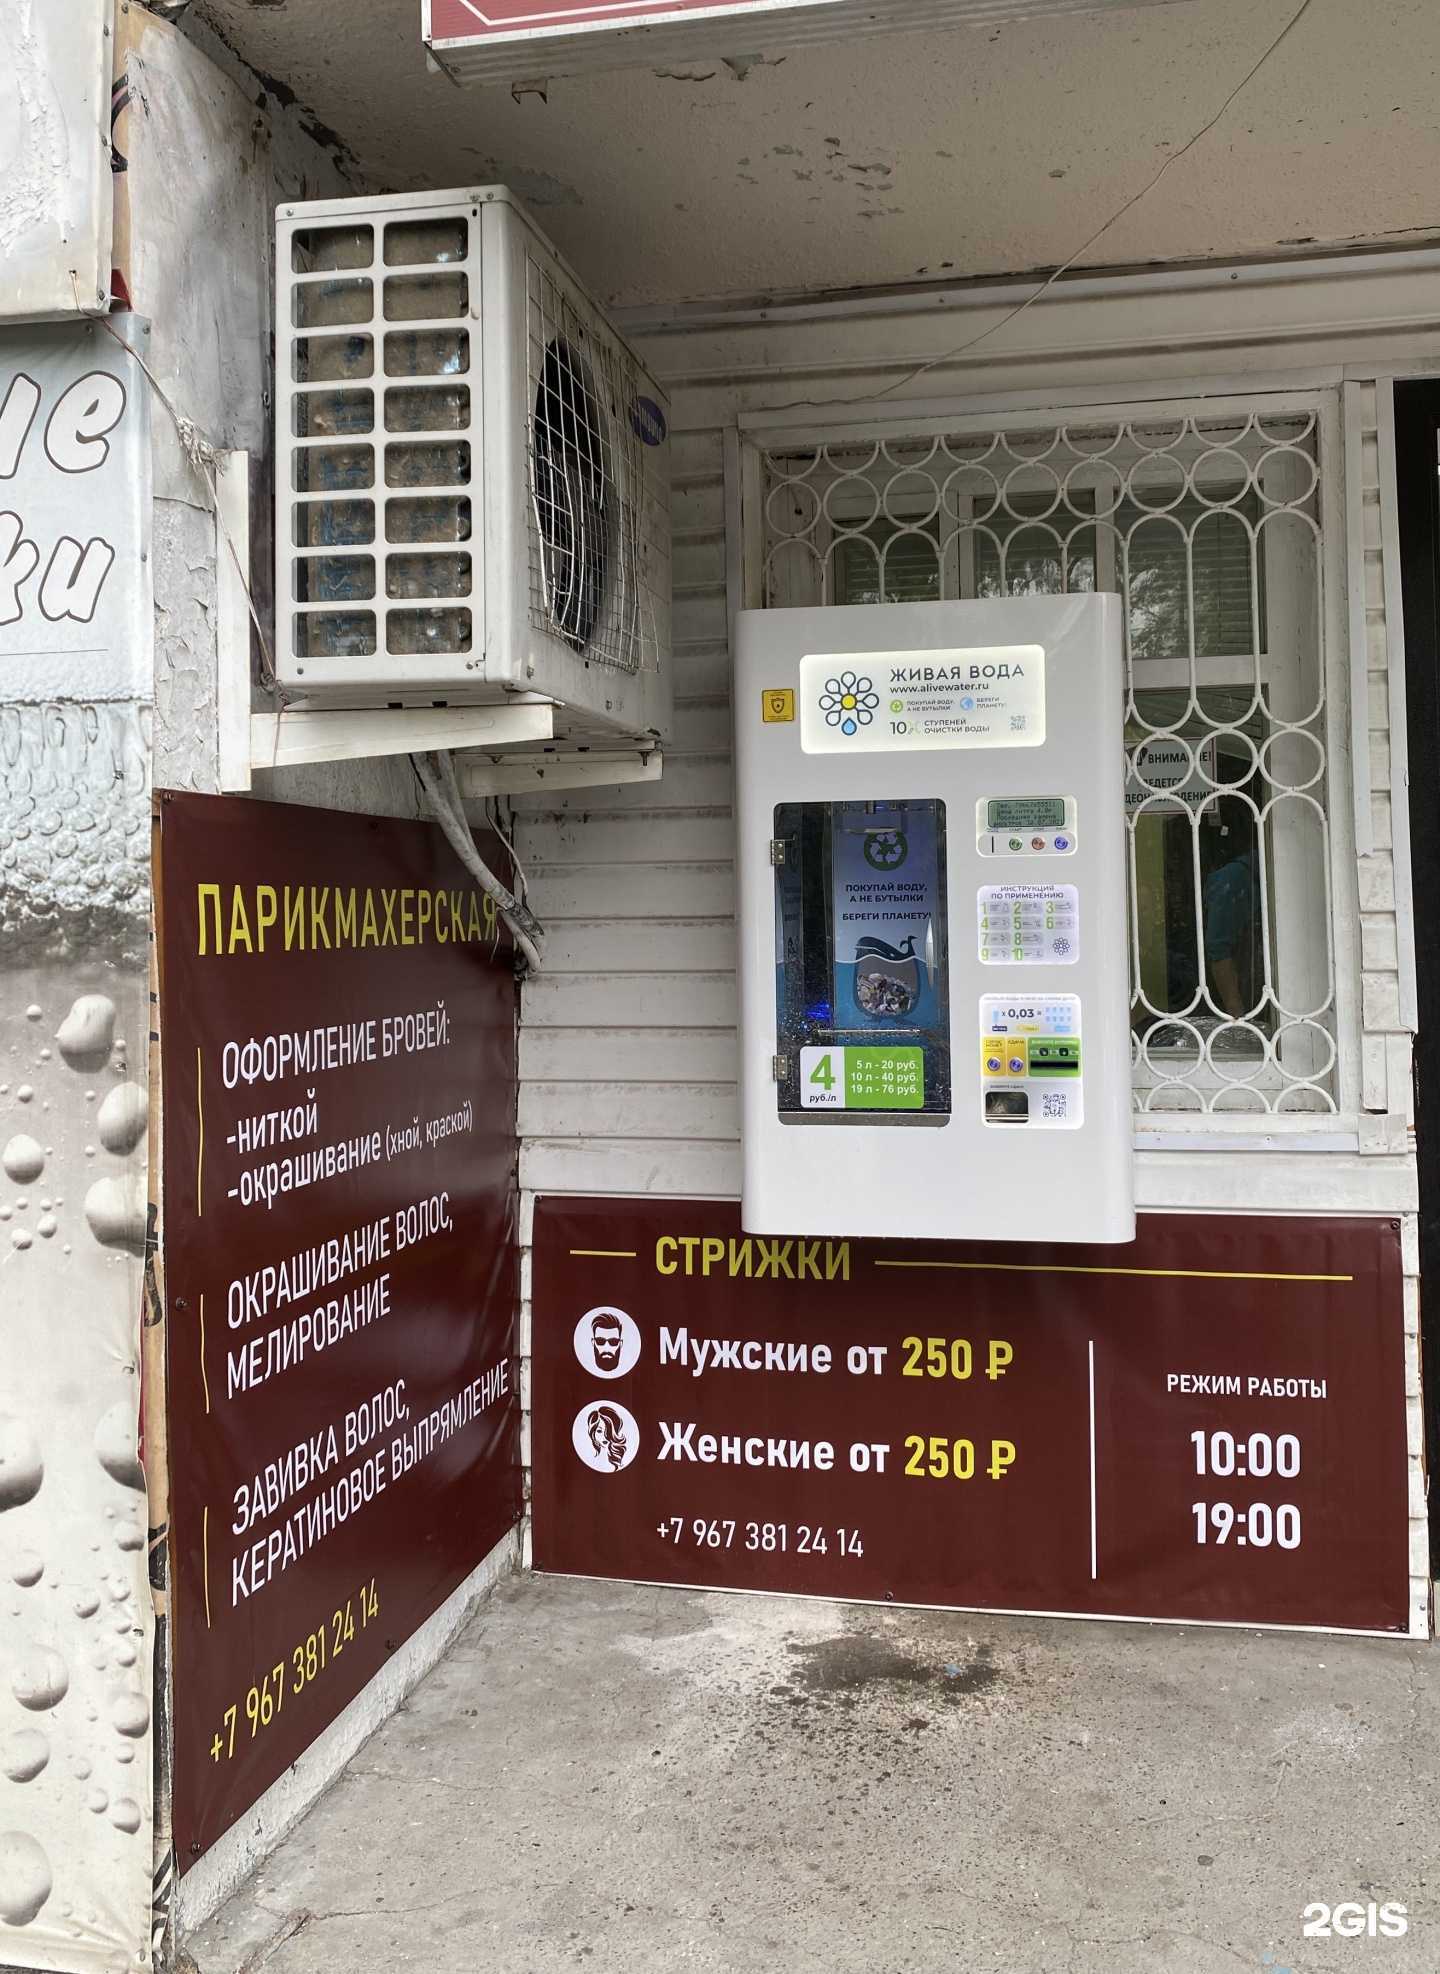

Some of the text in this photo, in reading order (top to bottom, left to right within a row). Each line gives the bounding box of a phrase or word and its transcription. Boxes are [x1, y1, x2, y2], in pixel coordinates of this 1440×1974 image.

[890, 664, 1025, 682] ЖИВАЯ ВОДА
[890, 682, 989, 694] www.alivewater.ru
[890, 721, 907, 735] 10
[924, 719, 966, 727] СТУПЕНЕЙ
[924, 725, 990, 735] ОЧИСТКИ ВОДЫ
[845, 882, 896, 892] ПОКУПАЙ
[875, 894, 924, 902] БУТЫЛКИ
[981, 901, 987, 915] 1
[1013, 901, 1022, 915] 2
[1046, 901, 1054, 914] 3
[198, 884, 496, 956] ПАРИКМАХЕРСКАЯ
[842, 912, 880, 921] БЕРЕГИ
[981, 917, 989, 930] 4
[1013, 916, 1022, 930] 5
[1046, 916, 1054, 930] 6
[981, 932, 989, 946] 7
[1014, 932, 1022, 946] 8
[1012, 948, 1023, 960] 10
[1008, 1008, 1035, 1020] 0,03
[222, 1000, 451, 1089] ОФОРМЛЕНИЕ БРОВЕЙ:
[810, 1054, 836, 1091] 4
[856, 1060, 863, 1069] 5
[881, 1060, 894, 1069] 20
[897, 1060, 919, 1072] руб.
[851, 1072, 863, 1081] 10
[881, 1072, 894, 1081] 40
[897, 1072, 919, 1083] руб.
[851, 1084, 863, 1093] 19
[882, 1084, 894, 1093] 76
[897, 1084, 919, 1096] руб.
[809, 1093, 837, 1104] руб./л
[226, 1088, 318, 1154] -ниткой
[227, 1099, 473, 1210] -окрашивание (хной, краской)
[227, 1191, 453, 1330] ОКРАШИВАНИЕ ВОЛОС,
[655, 1236, 850, 1281] СТРИЖКИ
[227, 1273, 391, 1400] МЕЛИРОВАНИЕ
[659, 1326, 832, 1377] Мужские
[847, 1346, 888, 1375] от
[901, 1336, 972, 1380] 250
[1166, 1373, 1327, 1399] РЕЖИМ РАБОТЫ
[232, 1378, 410, 1535] ЗАВИВКА ВОЛОС,
[657, 1421, 835, 1471] Женские
[849, 1444, 890, 1473] от
[904, 1435, 975, 1480] 250
[1190, 1430, 1300, 1478] 10:00
[232, 1358, 509, 1609] КЕРАТИНОВОЕ ВЫПРЯМЛЕНИЕ
[1192, 1502, 1301, 1550] 19:00
[656, 1517, 864, 1558] +7 967 381 24 14
[210, 1577, 379, 1763] +7 967 381 24 14
